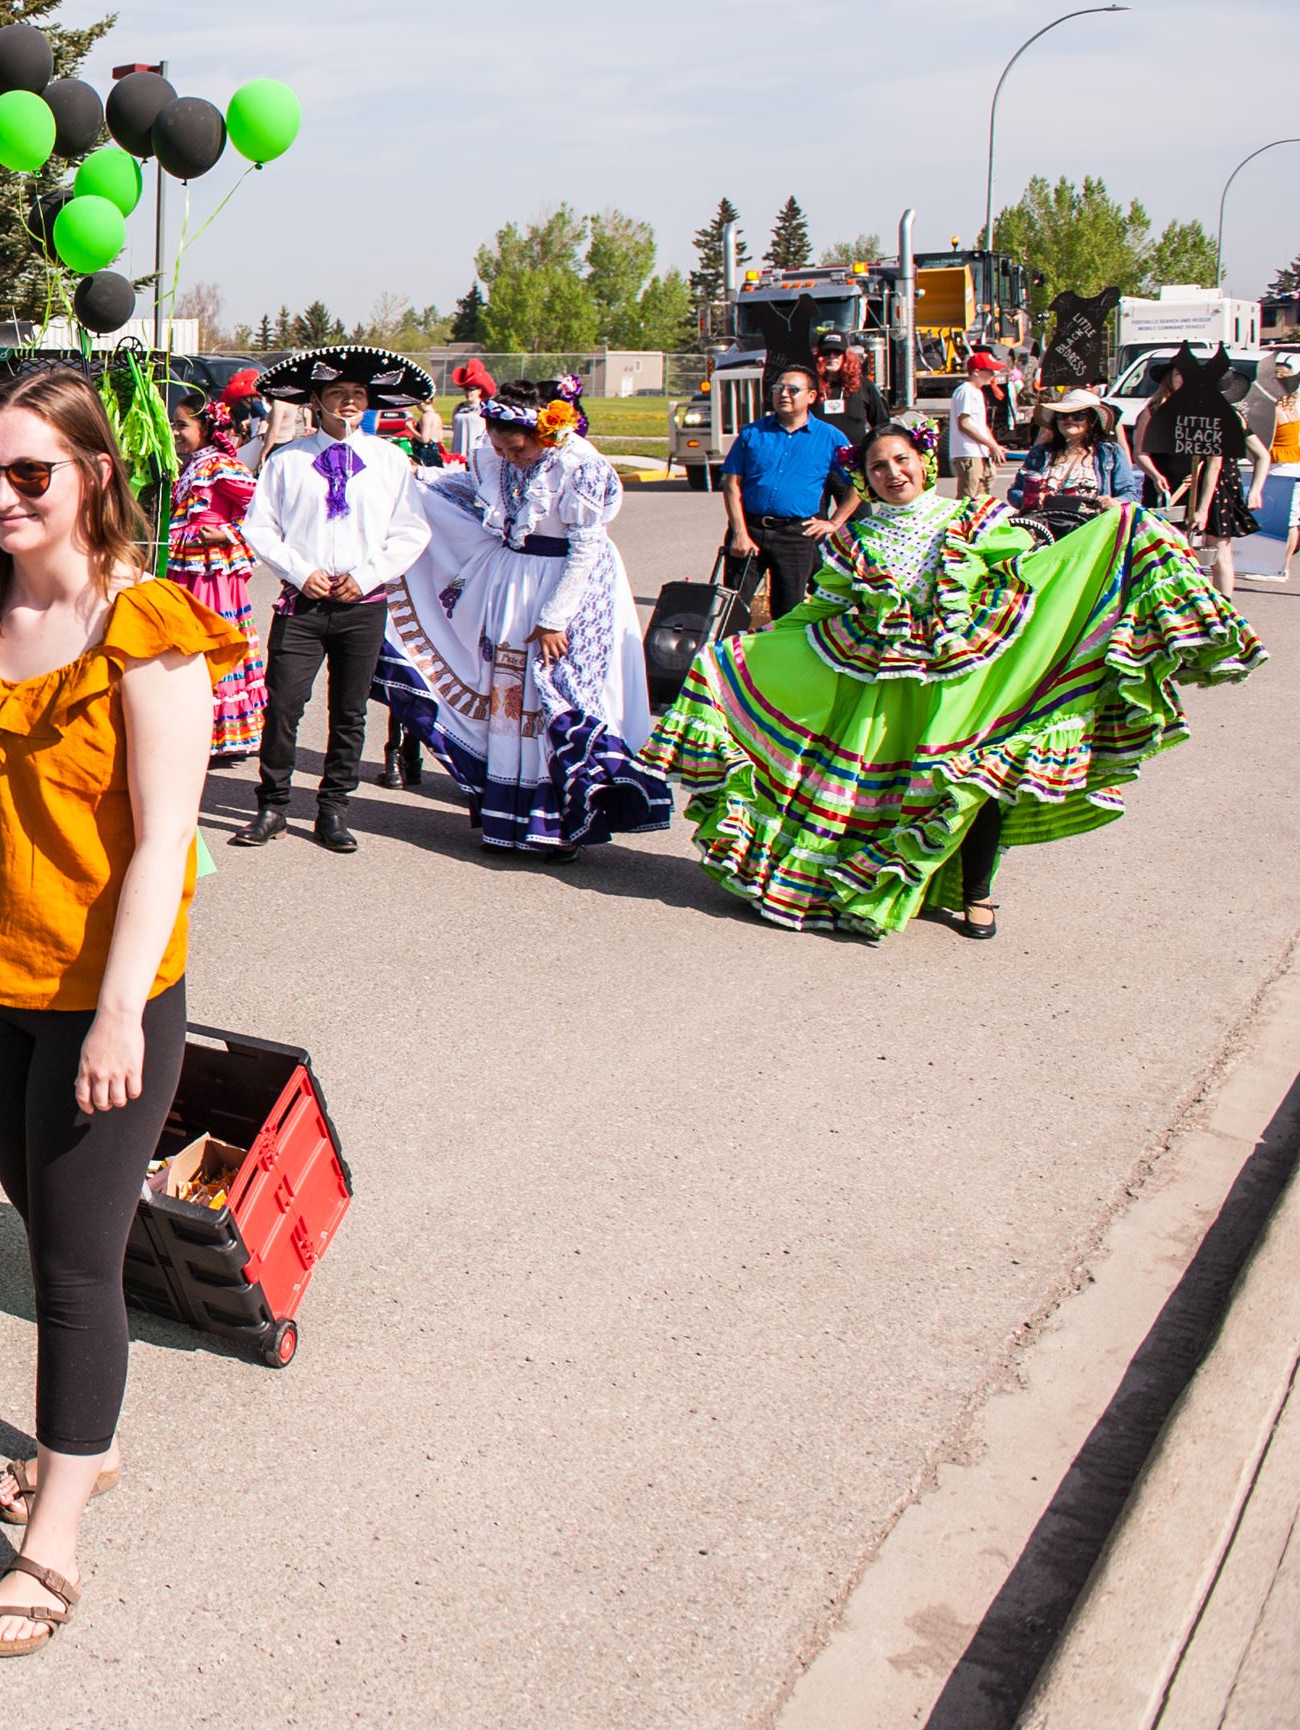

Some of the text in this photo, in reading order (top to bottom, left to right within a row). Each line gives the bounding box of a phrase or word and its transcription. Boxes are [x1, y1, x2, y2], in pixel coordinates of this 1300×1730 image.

[1072, 312, 1097, 338] LITTLE
[1055, 328, 1084, 354] BLACK
[1062, 348, 1087, 377] DRESS
[1176, 415, 1221, 430] LITTLE
[1175, 425, 1223, 443] BLACK
[1175, 440, 1222, 455] DRESS
